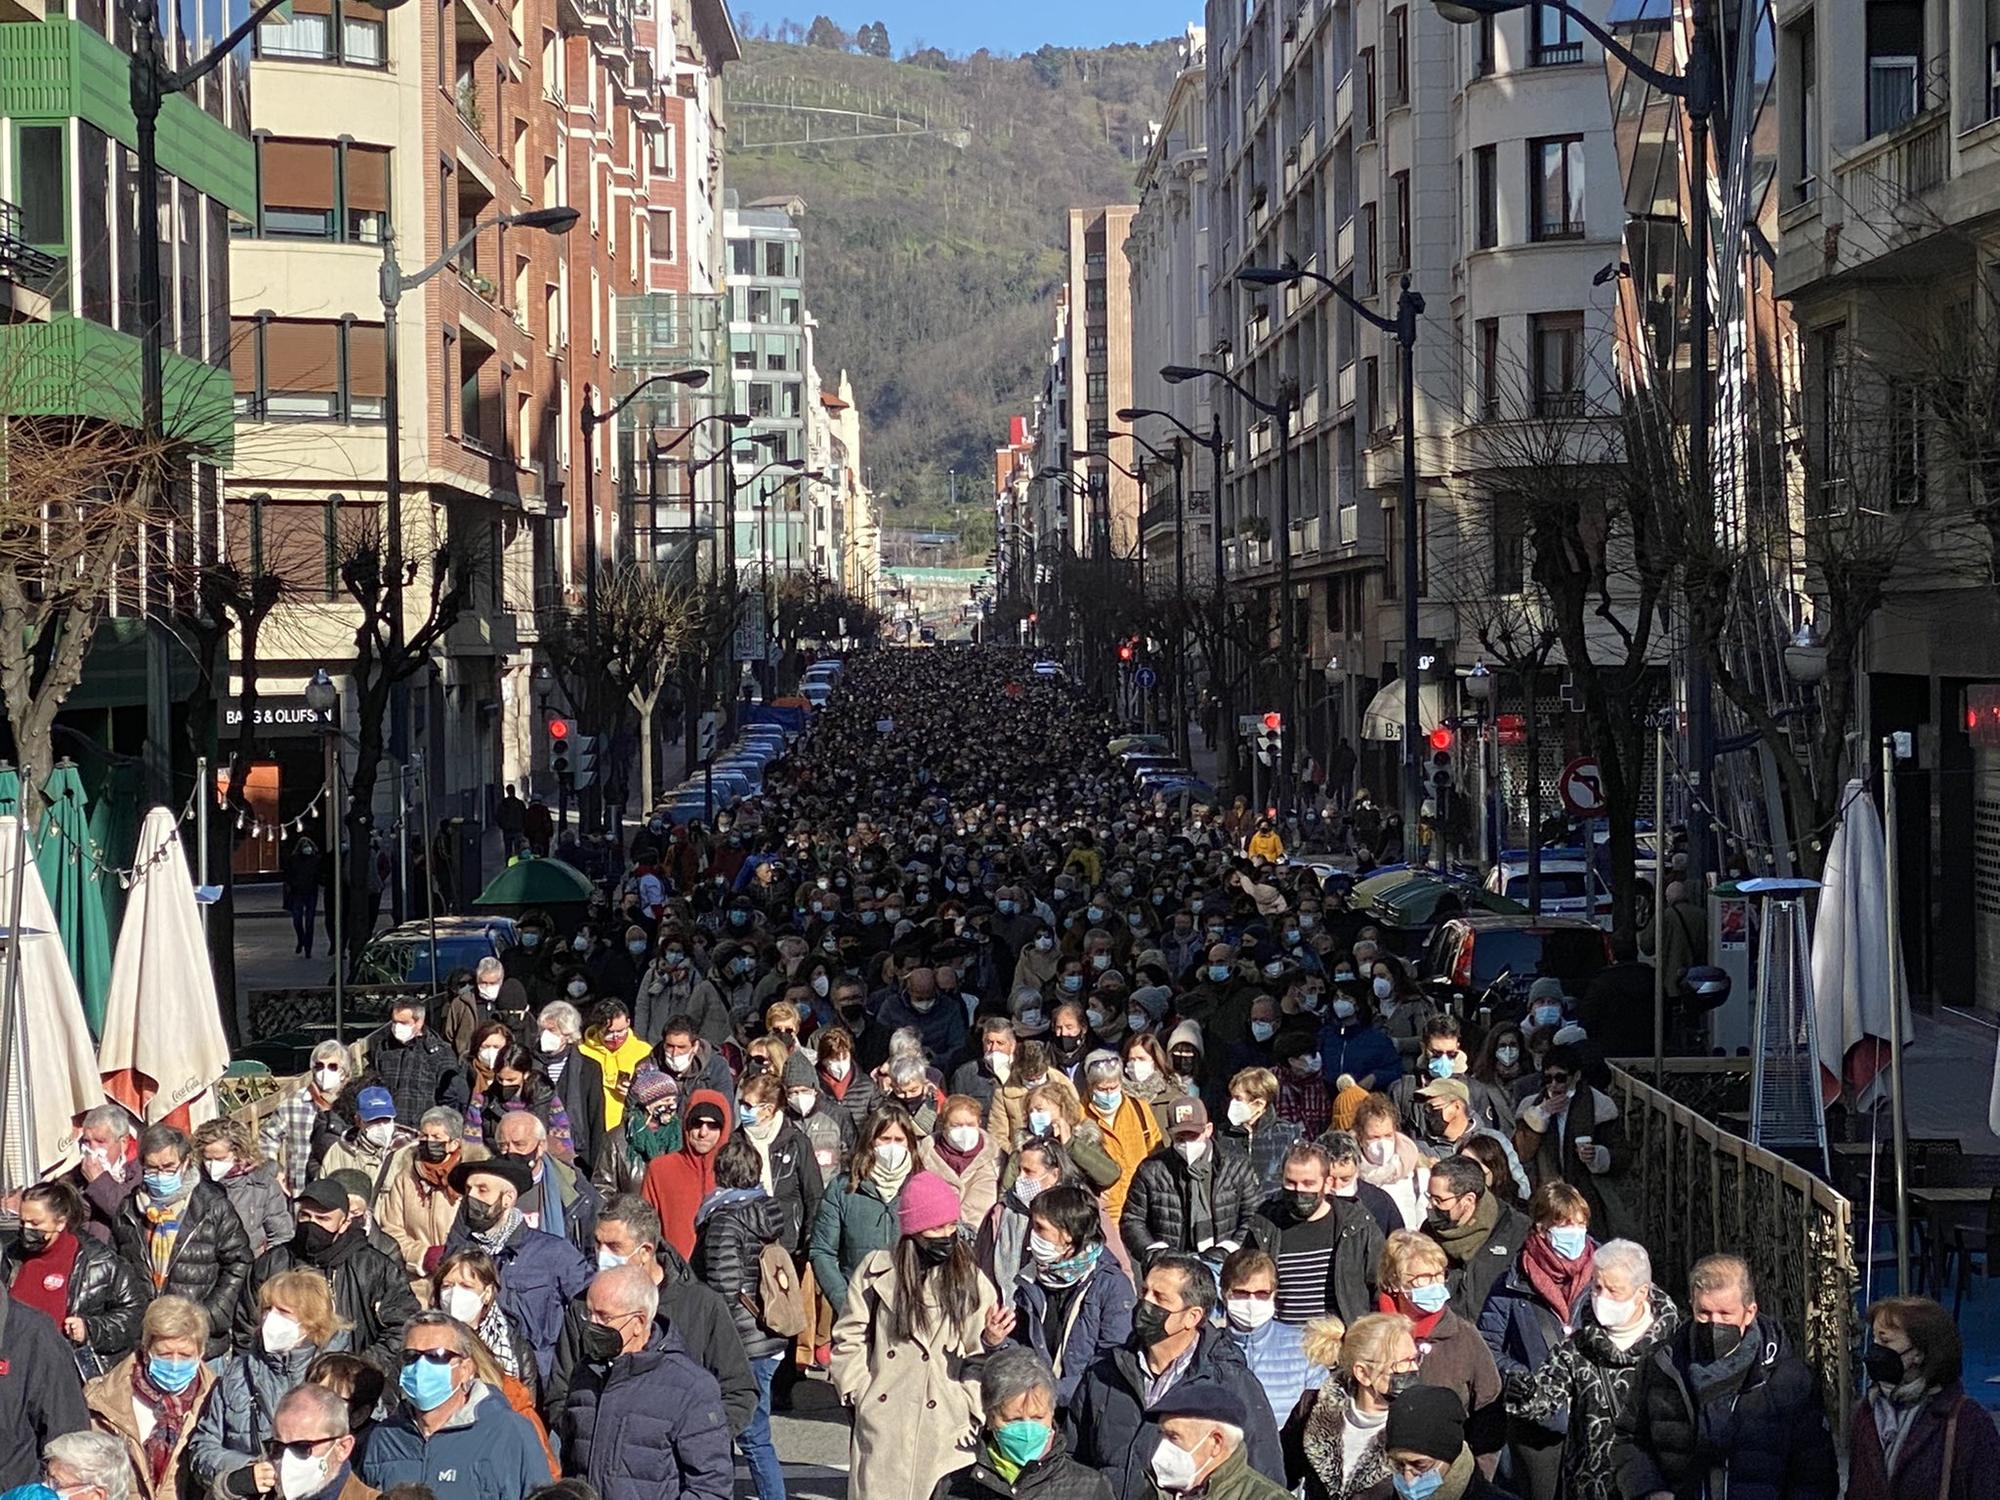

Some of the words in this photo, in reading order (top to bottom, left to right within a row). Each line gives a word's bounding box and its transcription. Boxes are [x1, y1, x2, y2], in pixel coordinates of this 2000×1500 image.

[226, 711, 262, 724] BAG
[263, 711, 274, 723] &
[275, 709, 332, 723] OLUFSN
[1385, 723, 1402, 738] BA
